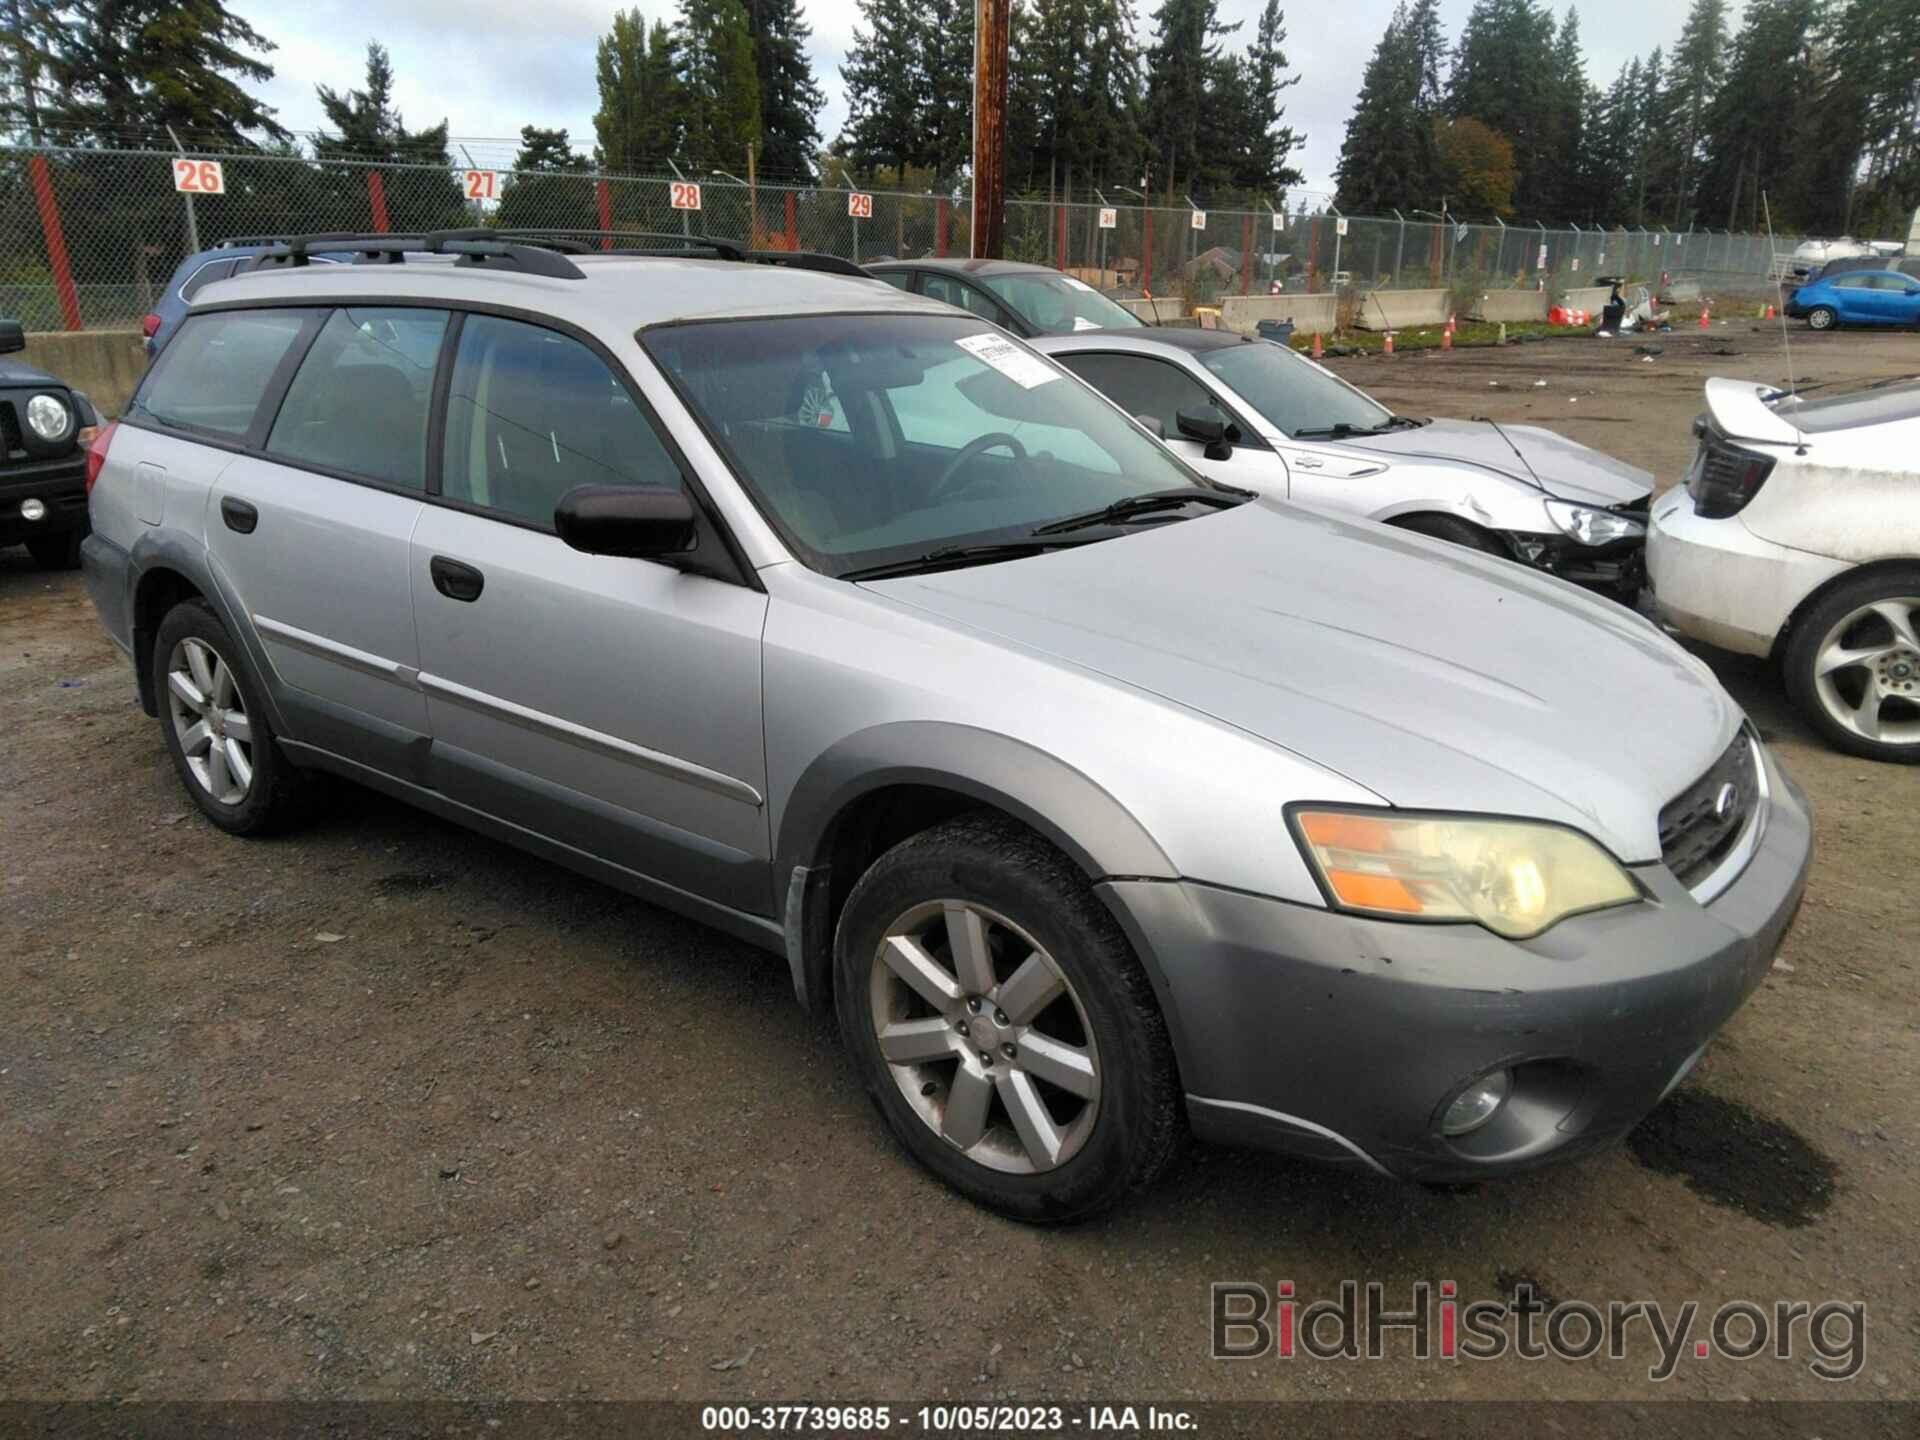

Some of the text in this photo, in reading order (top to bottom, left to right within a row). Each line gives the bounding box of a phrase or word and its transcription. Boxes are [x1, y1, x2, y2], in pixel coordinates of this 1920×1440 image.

[176, 161, 219, 192] 26
[467, 171, 494, 198] 27
[673, 184, 698, 208] 28
[851, 195, 870, 216] 29
